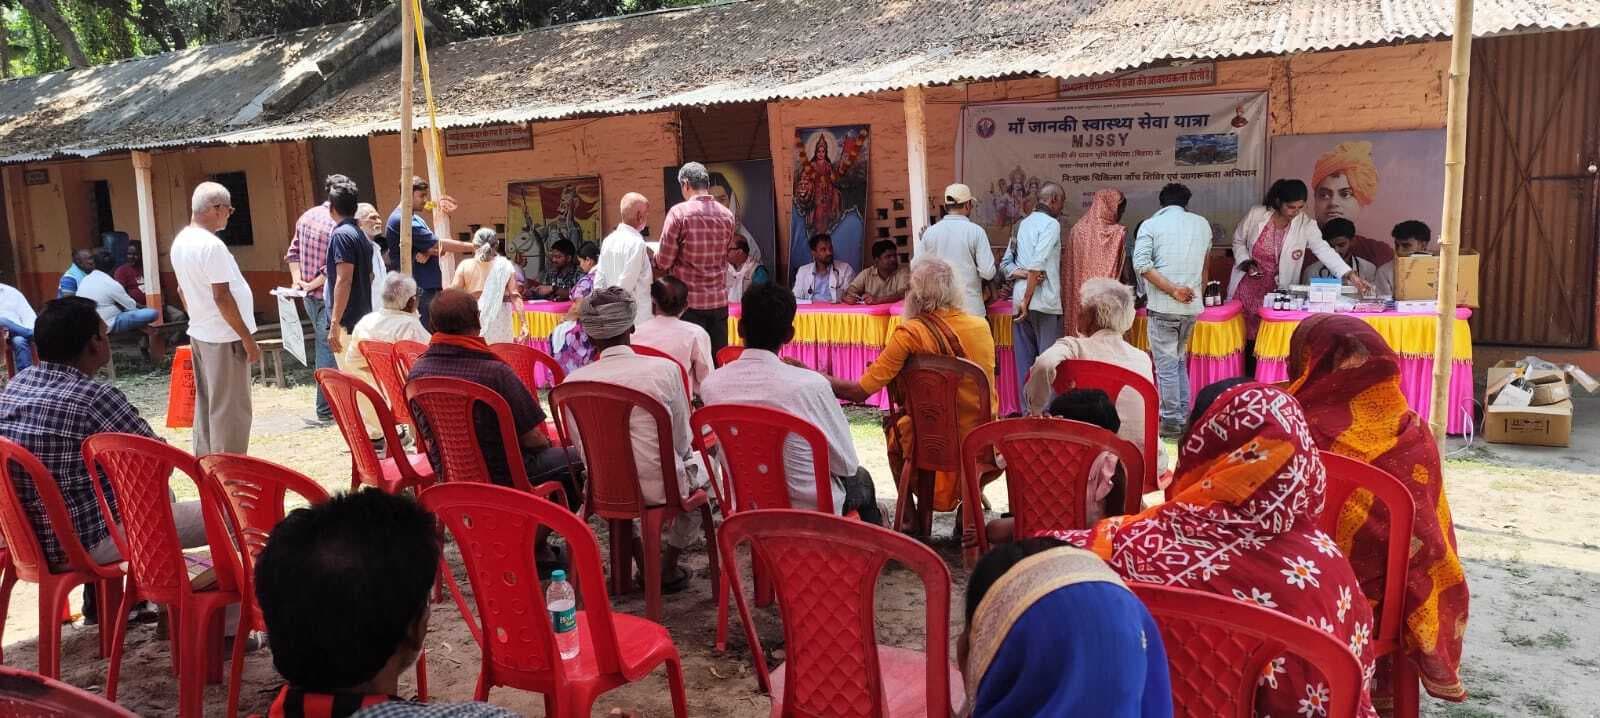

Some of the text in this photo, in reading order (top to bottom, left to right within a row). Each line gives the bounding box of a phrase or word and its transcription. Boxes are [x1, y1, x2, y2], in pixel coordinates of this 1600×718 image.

[1008, 112, 1210, 134] माँ जानकी स्वास्थ्य सेवा यात्रा
[1072, 132, 1129, 148] MJSSY
[1223, 168, 1257, 178] अभियान
